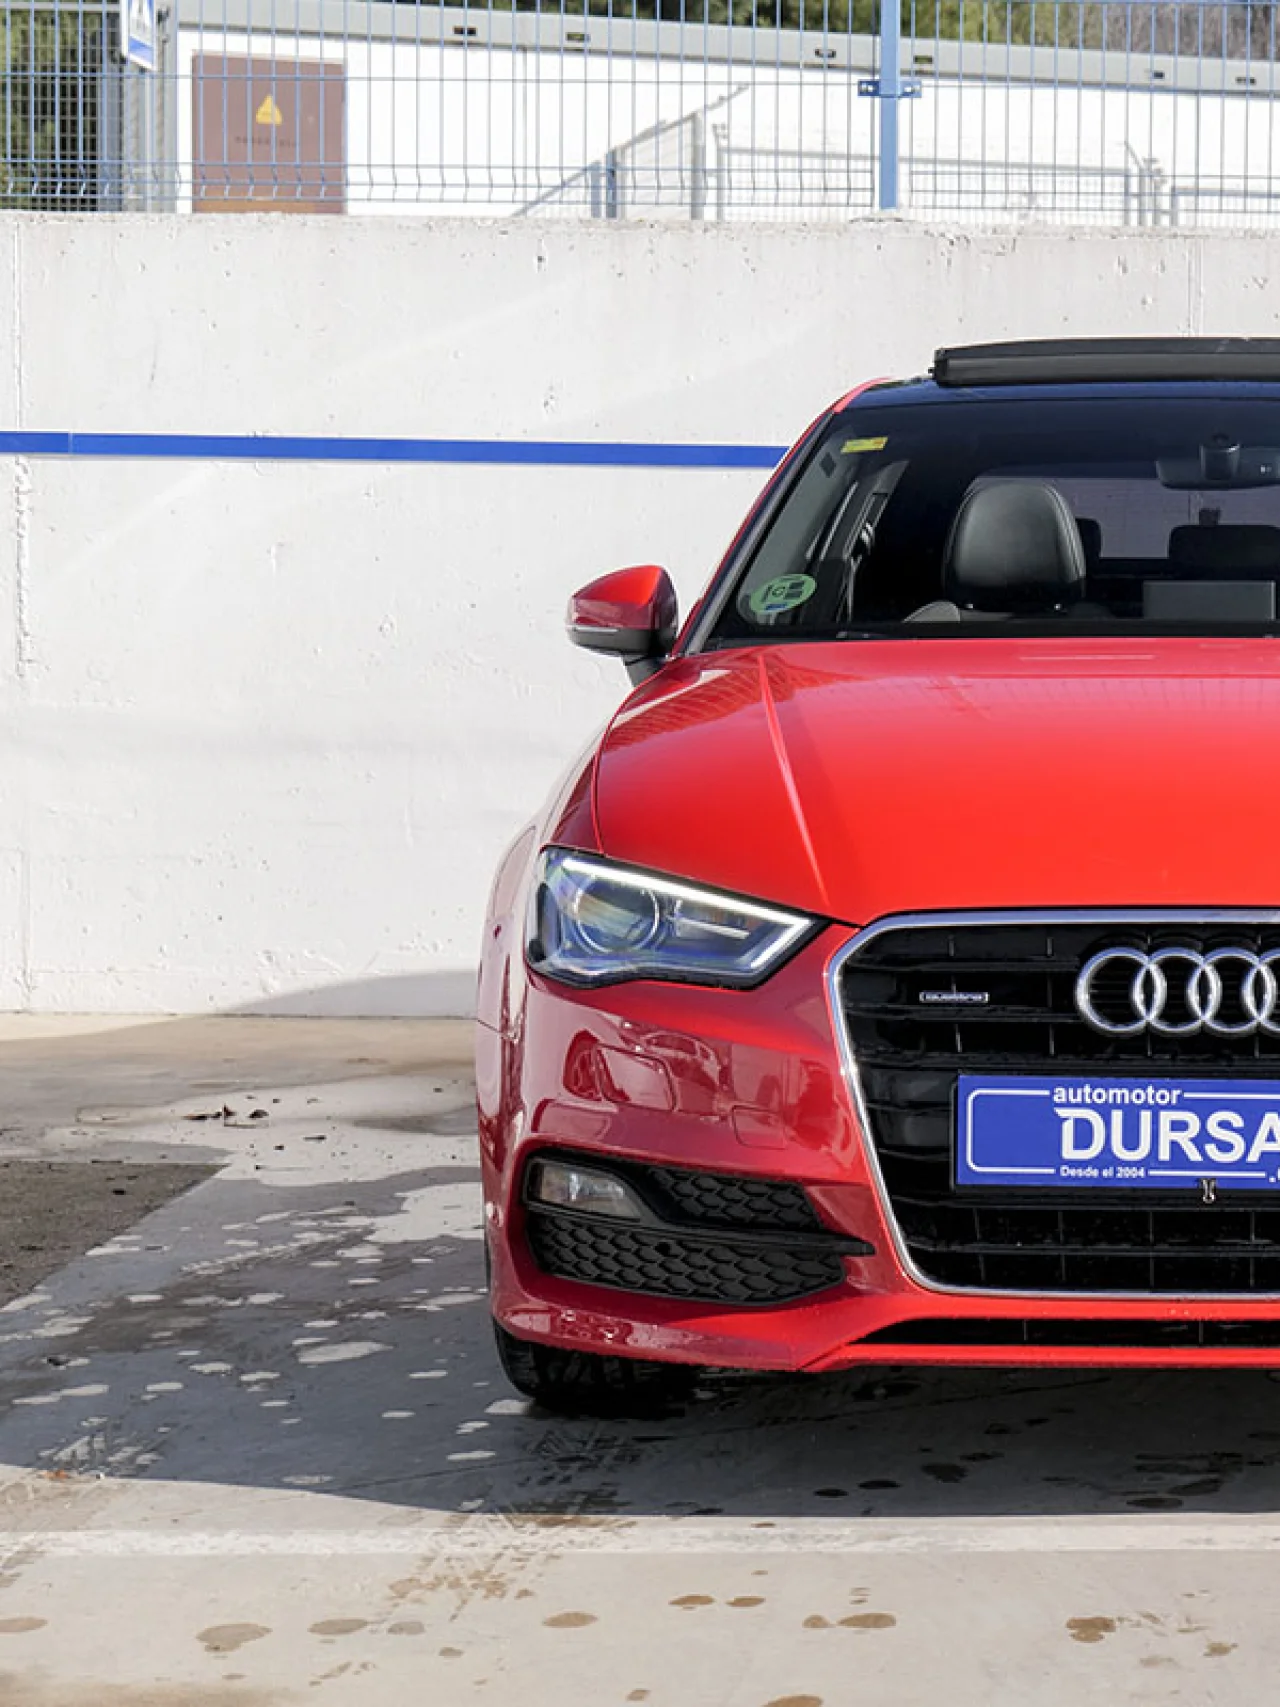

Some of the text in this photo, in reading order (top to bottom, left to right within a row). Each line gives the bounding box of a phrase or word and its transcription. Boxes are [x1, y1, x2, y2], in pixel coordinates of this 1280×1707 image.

[1053, 1083, 1182, 1105] automotor
[1060, 1165, 1099, 1179] Desde
[1102, 1166, 1115, 1179] el
